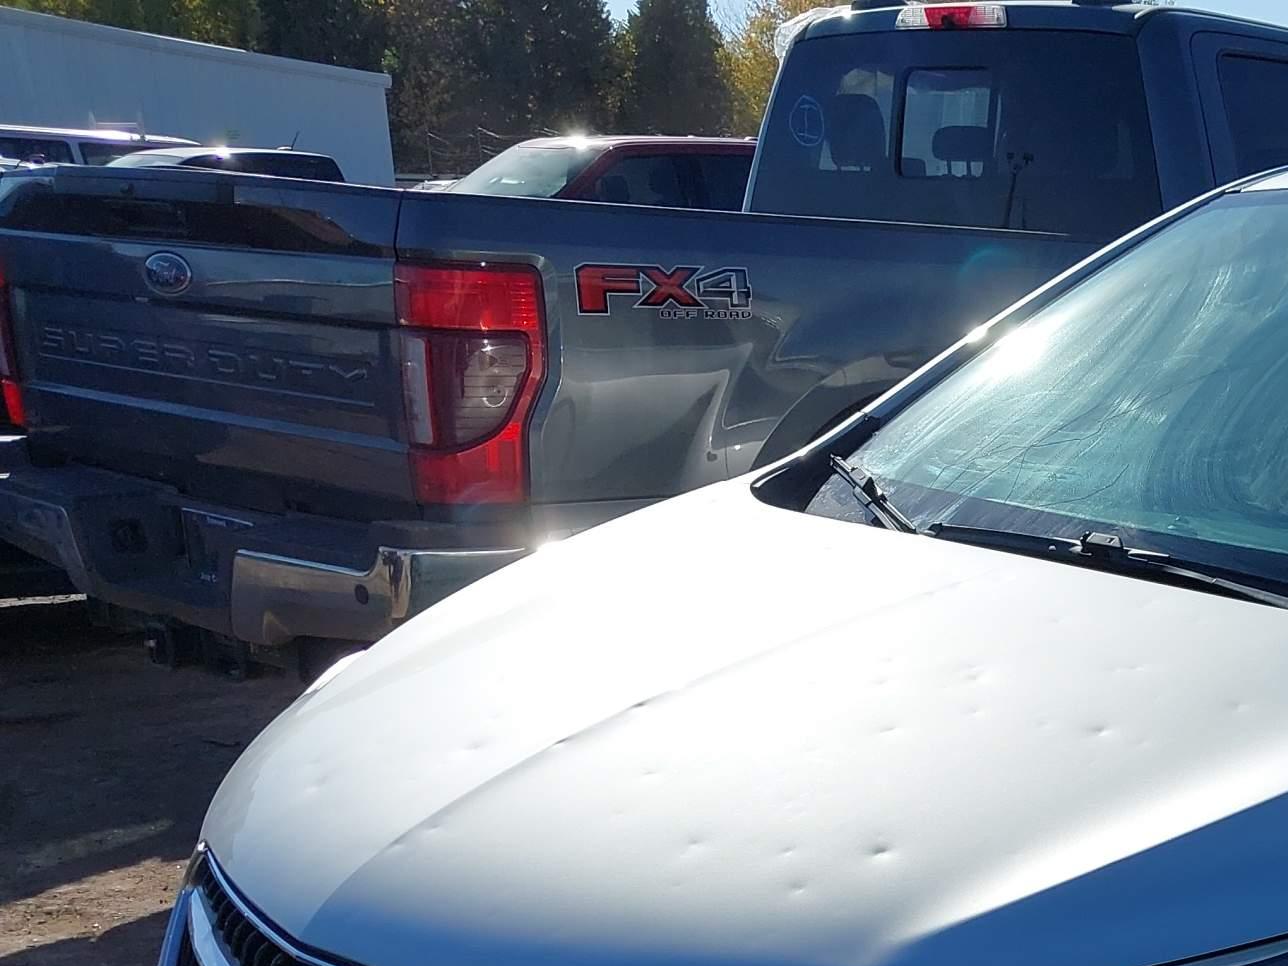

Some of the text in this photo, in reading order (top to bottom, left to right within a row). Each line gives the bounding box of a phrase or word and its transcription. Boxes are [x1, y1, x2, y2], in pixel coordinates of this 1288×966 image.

[573, 261, 753, 316] FX4
[659, 309, 753, 320] OFF ROAD
[44, 326, 377, 381] SUPER DUTY
